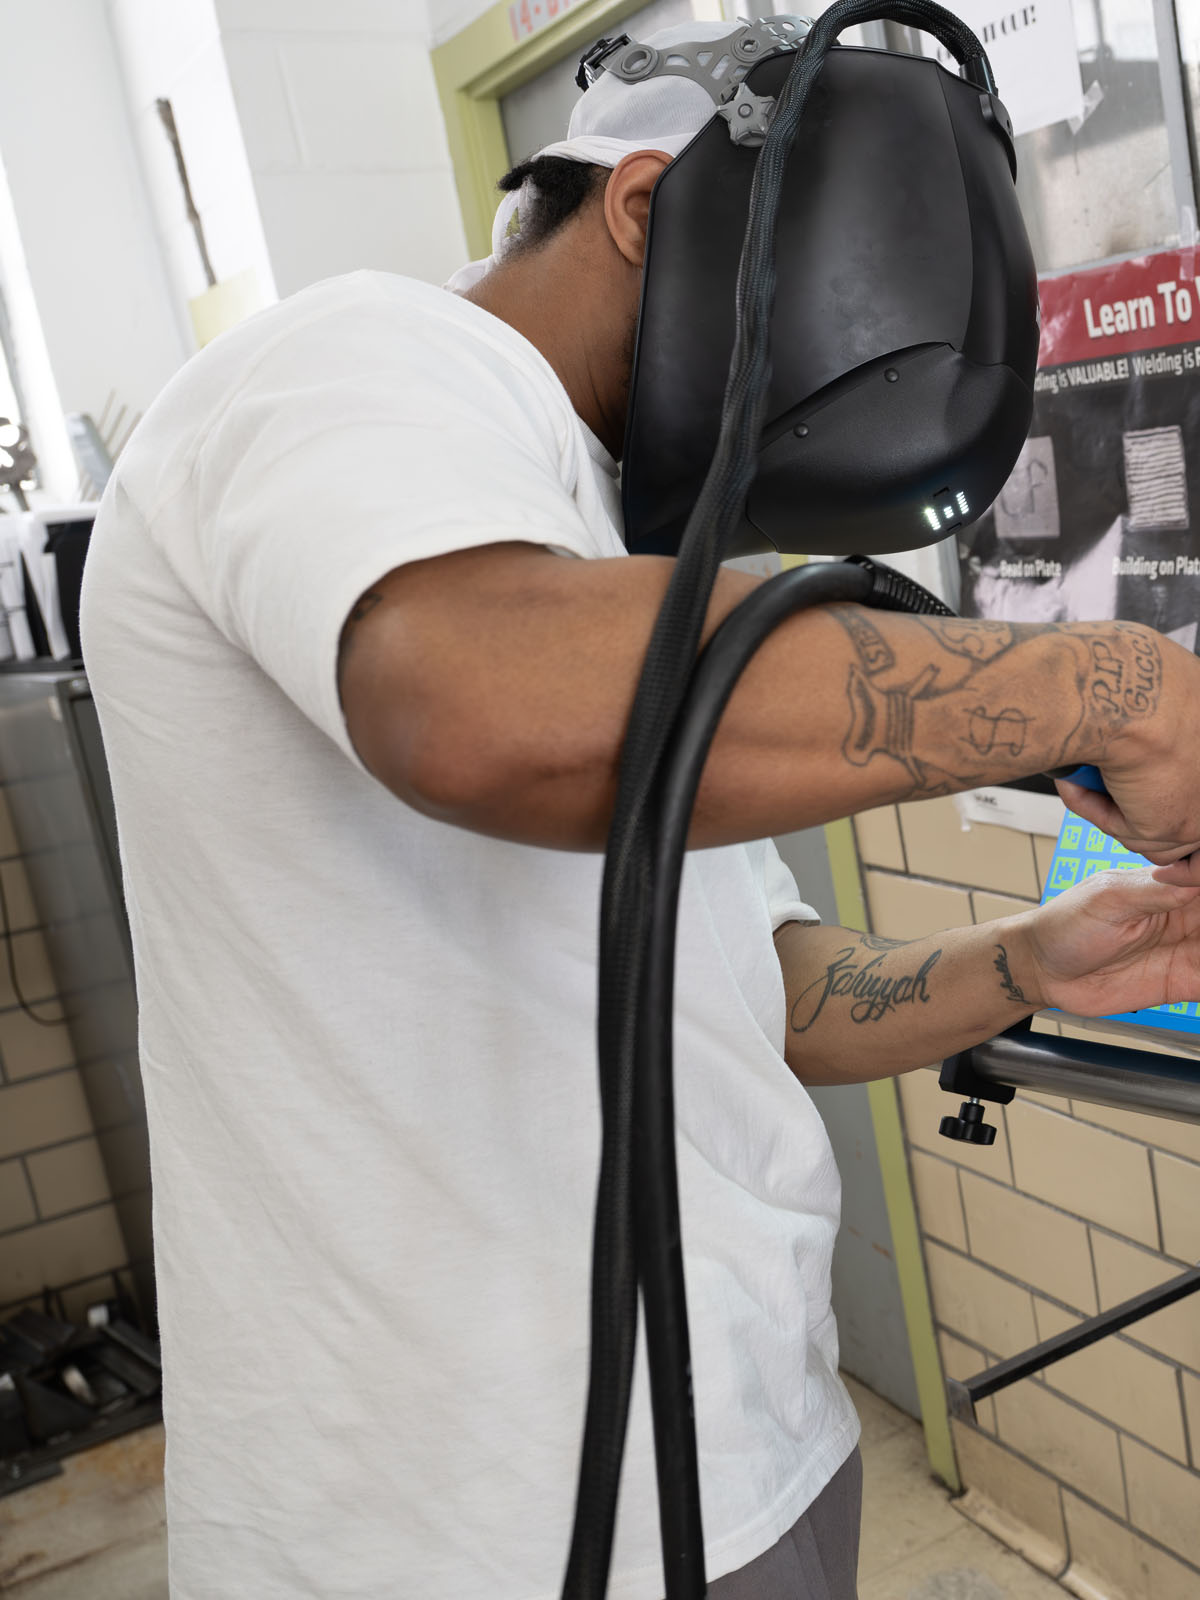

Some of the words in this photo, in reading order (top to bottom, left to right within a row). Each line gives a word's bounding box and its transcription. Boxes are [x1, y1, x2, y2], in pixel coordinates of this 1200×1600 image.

[1083, 295, 1155, 339] Learn
[1157, 281, 1192, 324] To
[1059, 369, 1068, 387] is
[1067, 358, 1129, 387] VALUABLE!
[1132, 352, 1183, 379] Welding
[1184, 350, 1195, 369] is
[1000, 559, 1022, 578] Bead
[1023, 563, 1036, 578] on
[1035, 559, 1062, 577] Plate
[1112, 556, 1158, 580] Building
[1159, 560, 1175, 576] on
